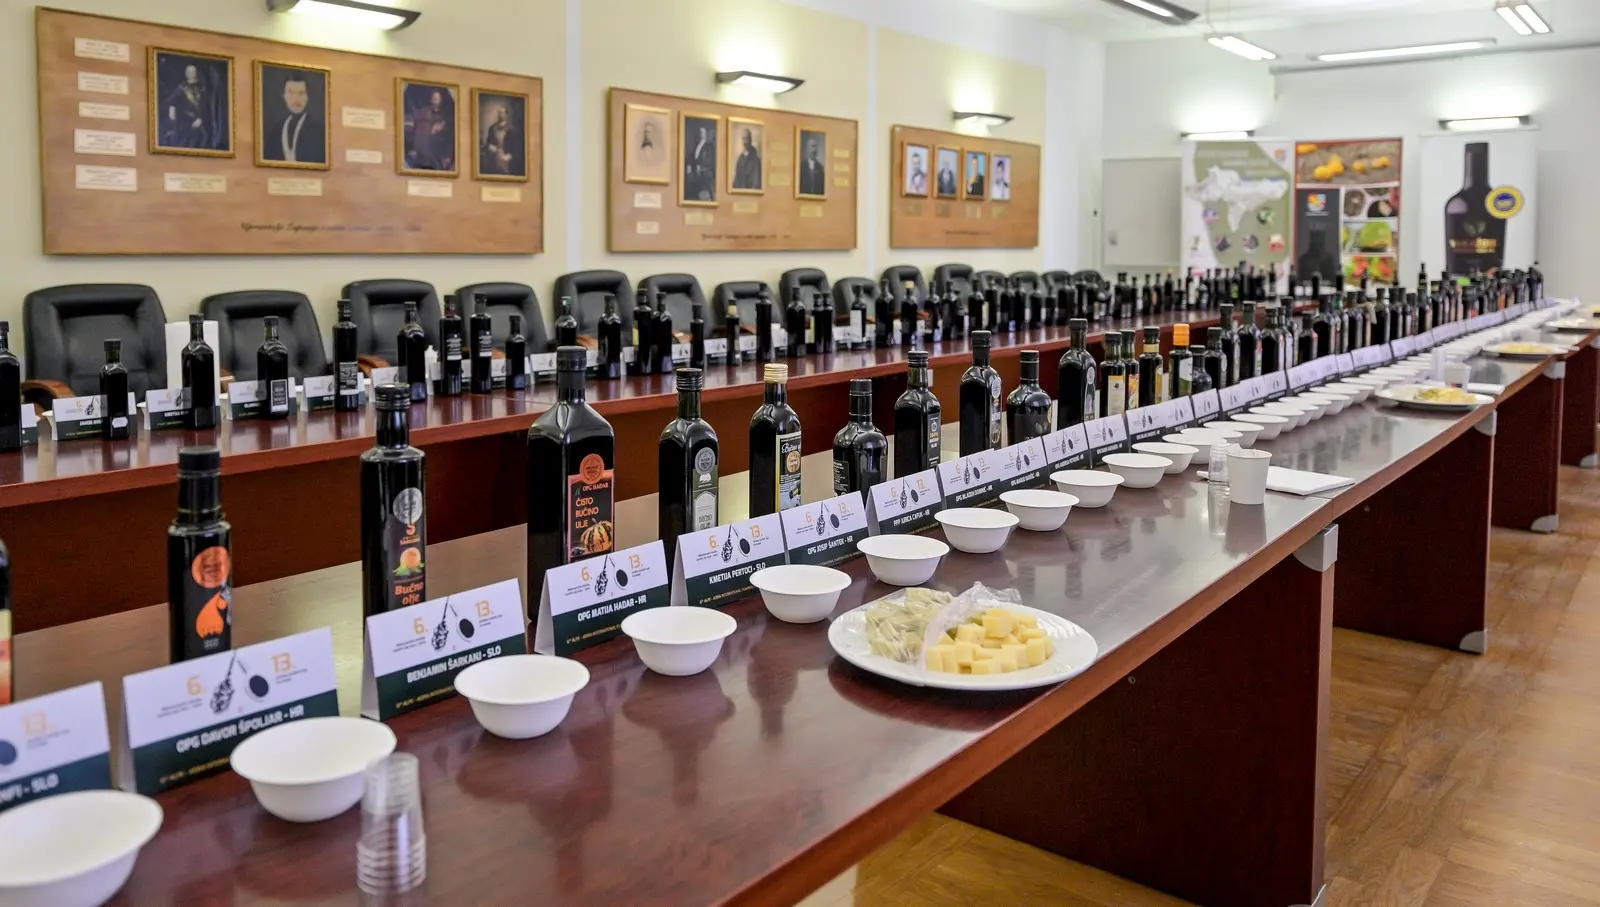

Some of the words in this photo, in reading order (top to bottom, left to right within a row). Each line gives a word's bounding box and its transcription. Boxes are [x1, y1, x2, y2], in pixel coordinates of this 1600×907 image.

[575, 496, 594, 507] ČISTO
[575, 507, 599, 518] BUČINO
[575, 520, 589, 529] ULJE
[749, 524, 763, 539] 13.
[708, 535, 720, 549] 6.
[807, 547, 817, 555] OPG
[816, 542, 828, 553] JOSIP
[828, 538, 845, 549] ŠANTEK
[846, 535, 854, 543] HR
[629, 554, 643, 569] 13.
[755, 562, 766, 571] SLO
[581, 566, 592, 581] 6.
[475, 600, 493, 618] 13.
[577, 610, 591, 622] OPG
[613, 598, 635, 612] HADAR
[638, 595, 647, 604] HR
[413, 617, 428, 634] 6.
[271, 652, 295, 673] 13.
[407, 660, 448, 684] BENJAMIN
[486, 645, 502, 658] SLO
[186, 675, 206, 696] 6.
[176, 735, 201, 753] OPG
[200, 725, 239, 747] DAVOR
[289, 704, 305, 720] HR
